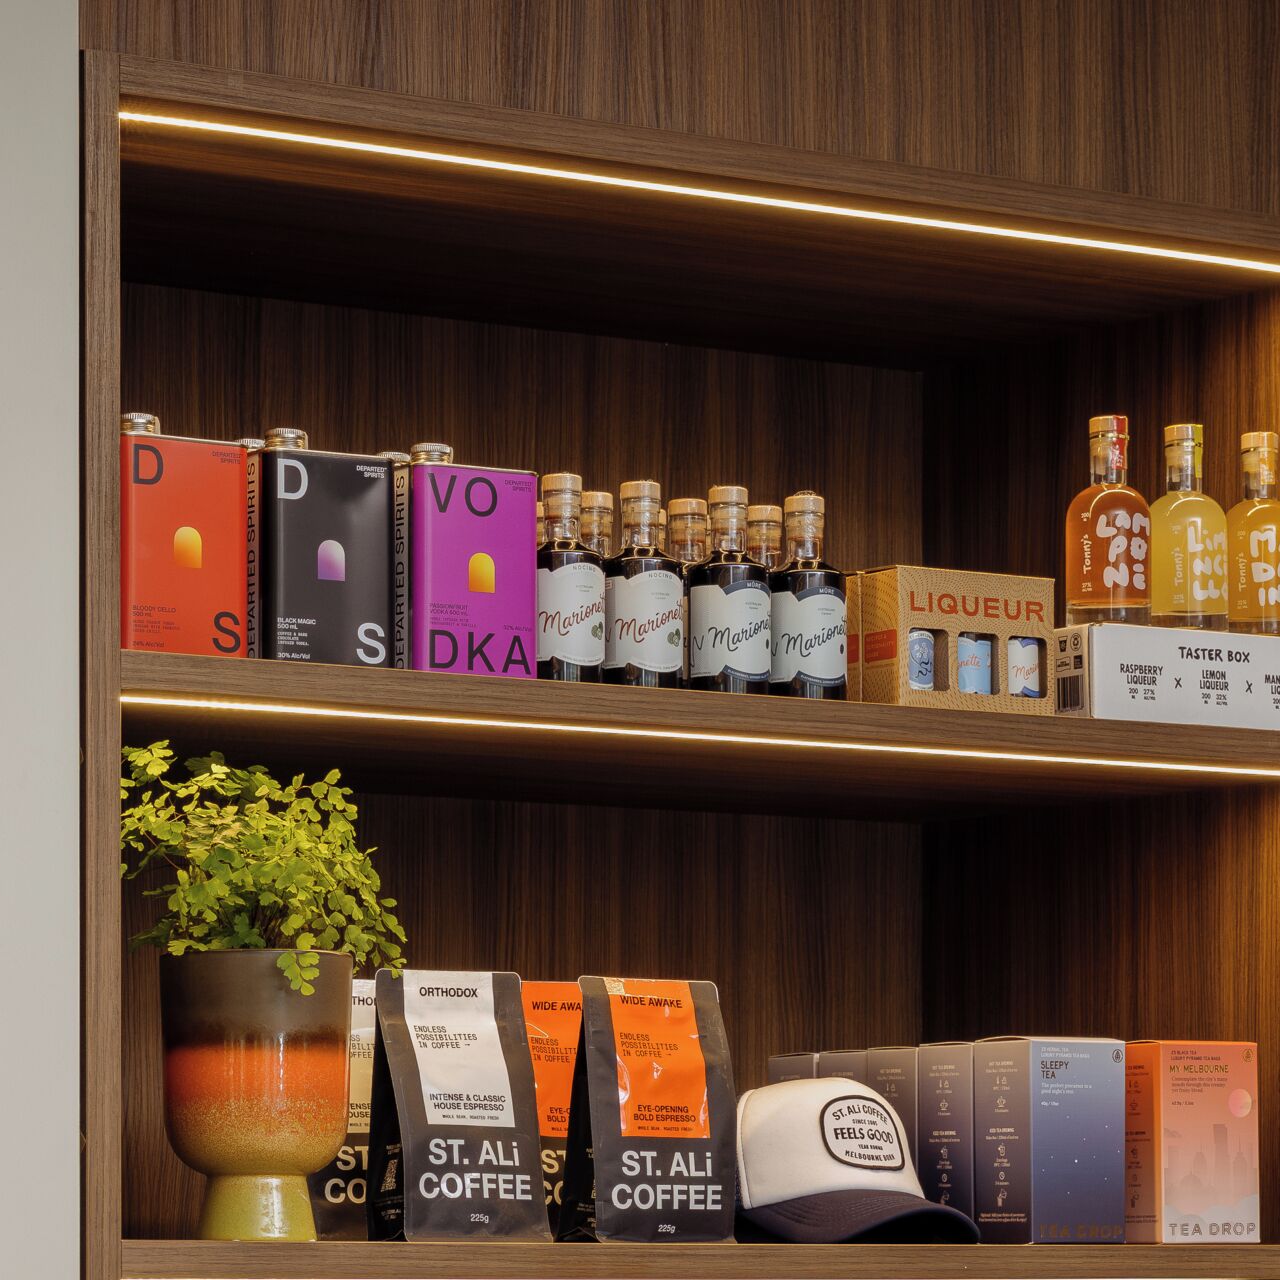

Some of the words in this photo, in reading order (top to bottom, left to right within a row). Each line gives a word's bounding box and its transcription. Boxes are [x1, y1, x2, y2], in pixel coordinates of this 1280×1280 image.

[132, 444, 164, 485] D
[277, 458, 308, 500] D
[364, 471, 385, 479] SPIRITS
[428, 473, 497, 517] VO
[247, 462, 256, 543] SPIRITS
[395, 475, 405, 555] SPIRITS
[1083, 534, 1093, 574] Tonny's
[573, 565, 596, 573] NOCINO
[1174, 547, 1184, 586] Tonny's
[1238, 552, 1247, 592] Tonny's
[247, 550, 256, 658] DEPARTED
[909, 591, 1044, 623] LIQUEUR
[395, 561, 405, 669] DEPARTED
[211, 611, 240, 653] S
[356, 622, 386, 664] S
[430, 629, 531, 675] DKA
[1178, 647, 1223, 663] TASTER
[1227, 649, 1251, 663] BOX
[1120, 663, 1163, 676] RASPBERRY
[1202, 669, 1226, 681] LEMON
[1127, 674, 1157, 686] LIQUEUR
[1199, 679, 1229, 691] LIQUEUR
[1128, 687, 1138, 695] 200
[1143, 688, 1155, 696] 27%
[1215, 693, 1227, 701] 32%
[420, 987, 478, 998] ORTHODOX
[532, 1001, 557, 1011] WIDE
[620, 996, 646, 1006] WIDE
[648, 998, 683, 1008] AWAKE
[414, 1025, 447, 1033] ENDLESS
[416, 1033, 478, 1041] POSSIBILITIES
[531, 1037, 559, 1047] ENDLESS
[620, 1032, 650, 1041] ENDLESS
[431, 1041, 461, 1049] COFFEE
[621, 1041, 678, 1051] POSSIBILITIES
[533, 1053, 542, 1061] IN
[544, 1054, 570, 1063] COFFEE
[636, 1050, 662, 1058] COFFEE
[1041, 1060, 1070, 1070] SLEEPY
[1170, 1065, 1181, 1073] MY
[1184, 1065, 1229, 1073] MELBOURNE
[1041, 1070, 1056, 1079] TEA
[429, 1093, 464, 1101] INTENSE
[473, 1094, 506, 1103] CLASSIC
[434, 1102, 462, 1110] HOUSE
[463, 1103, 504, 1111] ESPRESSO
[638, 1105, 689, 1113] EYE-OPENING
[634, 1113, 654, 1121] BOLD
[656, 1114, 696, 1122] ESPRESSO
[832, 1108, 847, 1121] ST.
[862, 1104, 888, 1125] COFFEE
[833, 1127, 865, 1140] FEELS
[867, 1128, 894, 1144] GOOD
[428, 1138, 470, 1165] ST.
[478, 1140, 520, 1166] ALi
[845, 1150, 883, 1162] MELBOURNE
[622, 1150, 662, 1177] ST.
[670, 1152, 712, 1177] ALi
[419, 1172, 533, 1200] COFFEE
[612, 1183, 722, 1210] COFFEE
[470, 1213, 490, 1223] 225g
[658, 1224, 676, 1234] 225g
[1169, 1223, 1203, 1236] TEA
[1209, 1223, 1257, 1236] DROP
